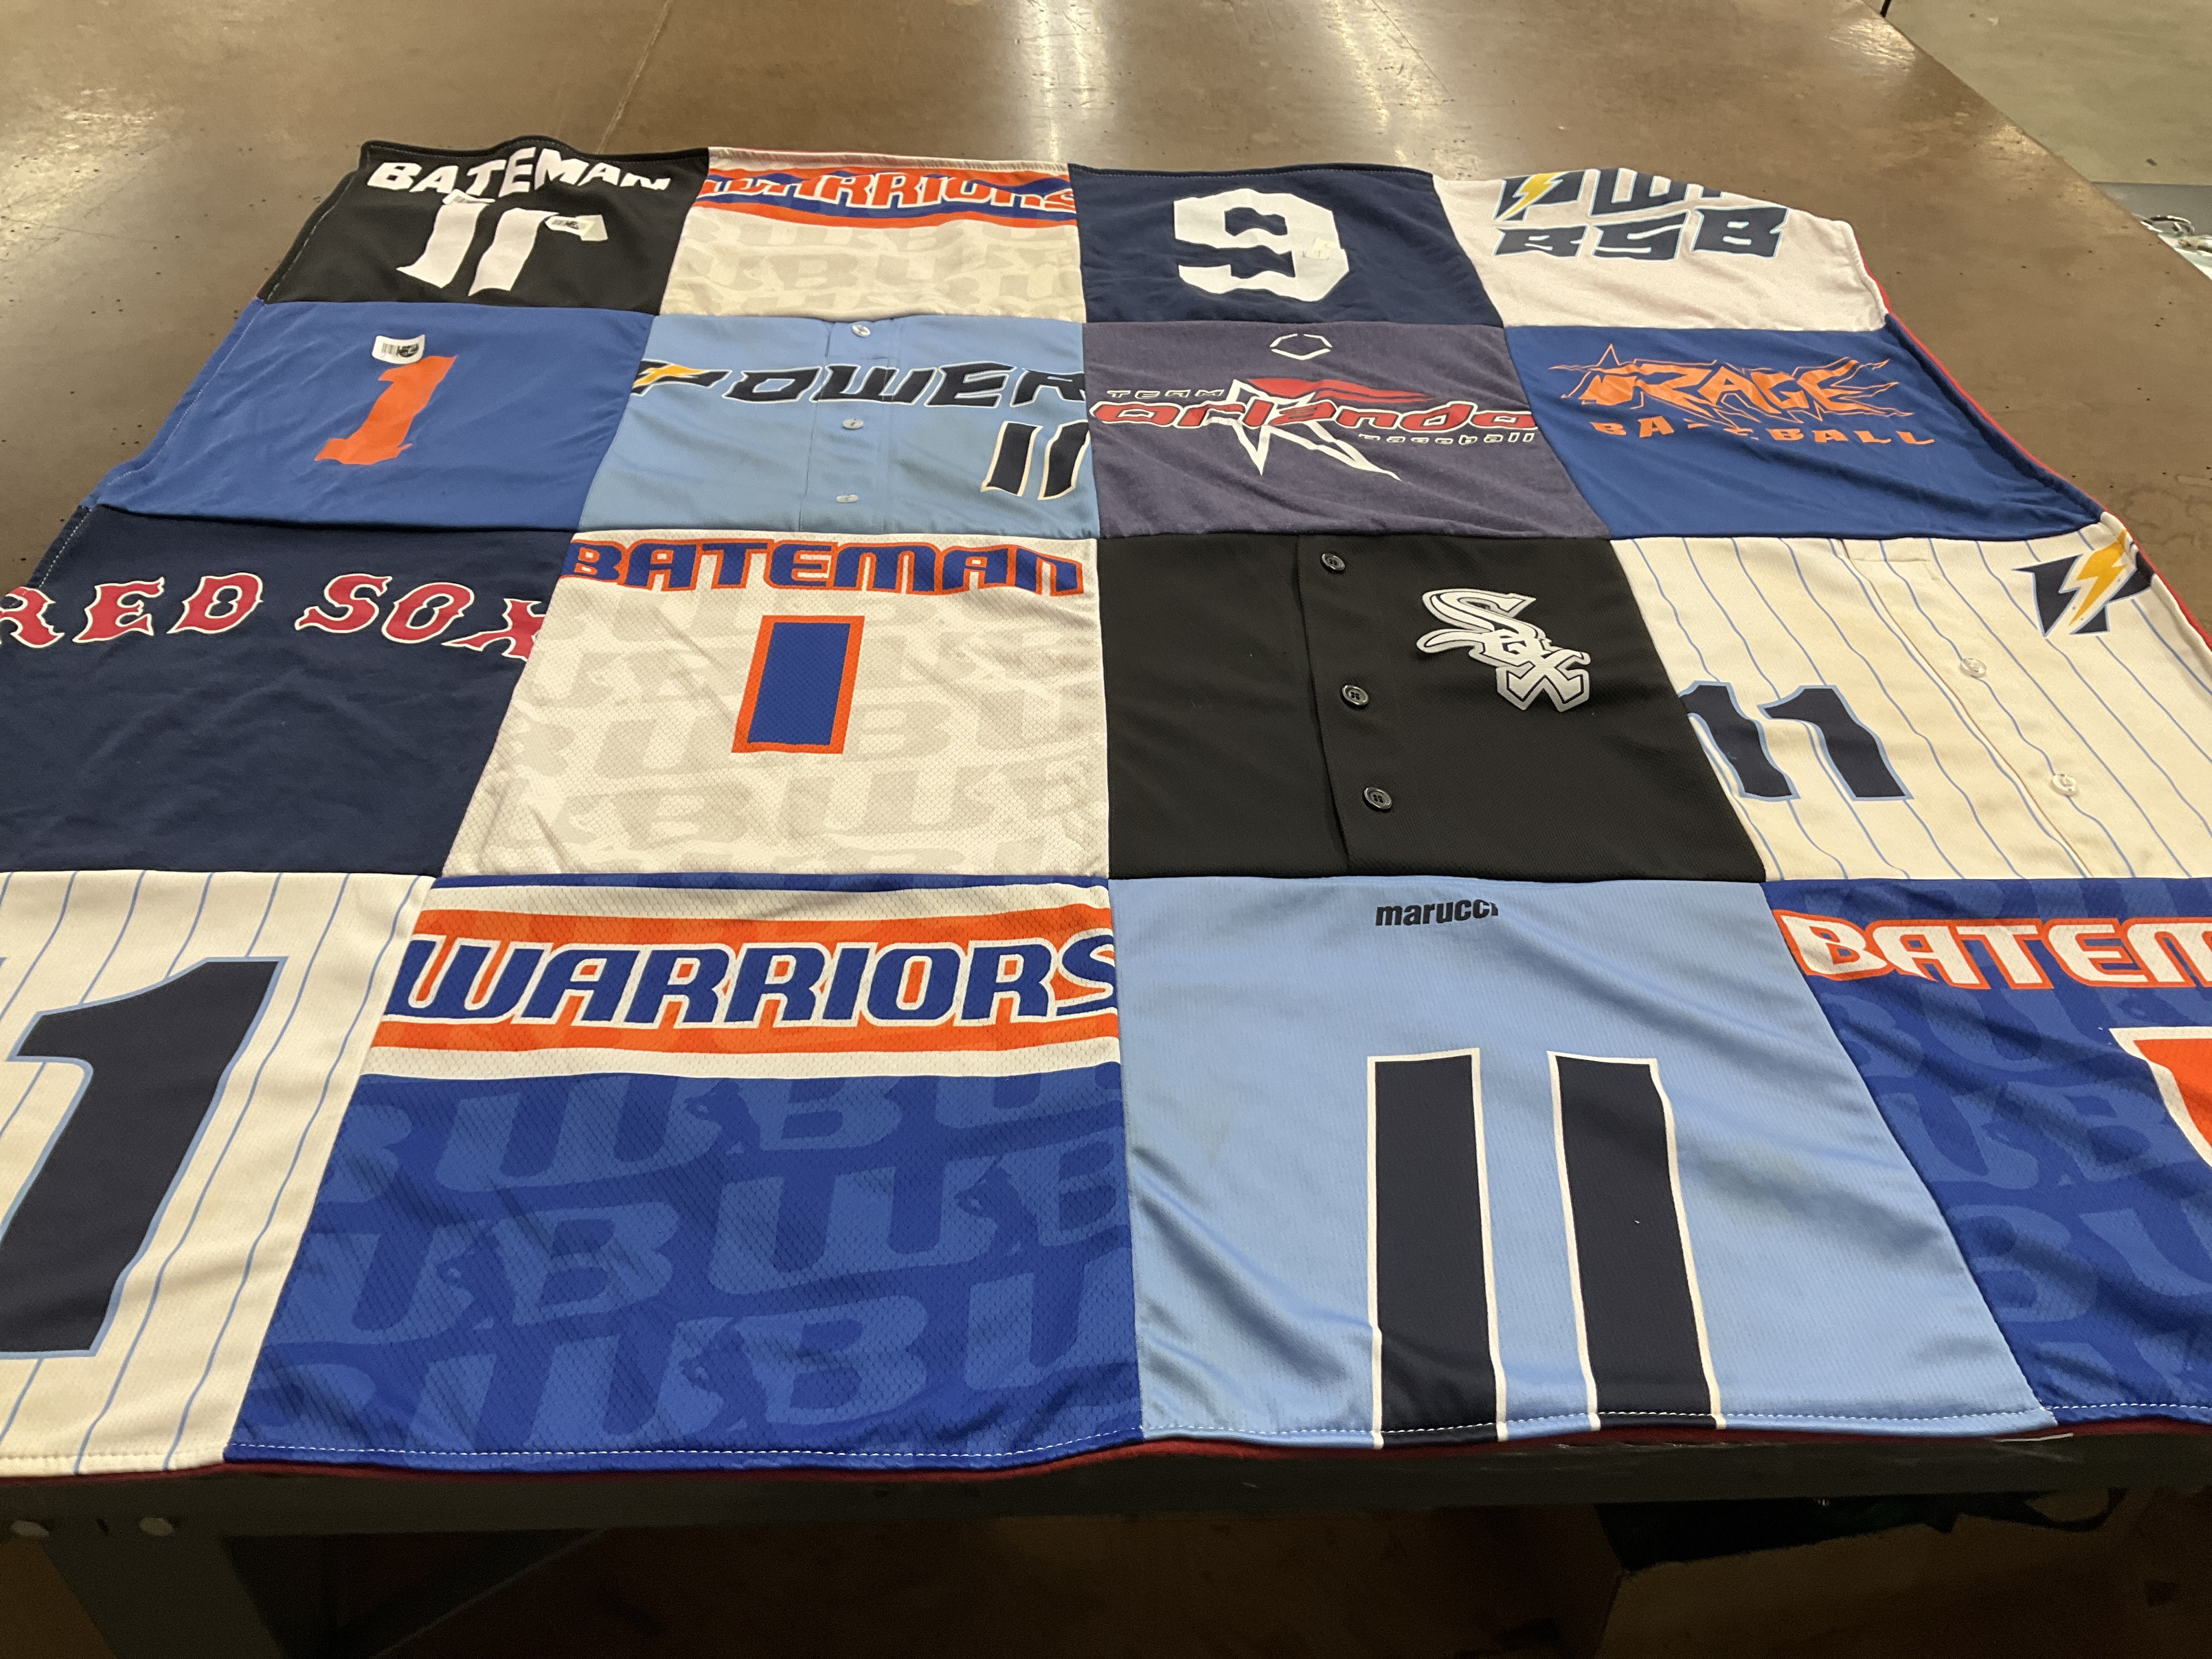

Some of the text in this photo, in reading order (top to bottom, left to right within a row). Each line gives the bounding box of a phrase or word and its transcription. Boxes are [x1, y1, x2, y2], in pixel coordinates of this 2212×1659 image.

[367, 147, 670, 198] BATEMAN
[1173, 188, 1350, 301] 9
[314, 356, 458, 465] 1
[630, 358, 1086, 408] POWER
[1564, 354, 1901, 421] RAGE
[1590, 415, 1934, 445] BABALL
[558, 538, 1084, 596] BATEMAN
[0, 572, 263, 648] RED
[1679, 680, 1914, 802] 11
[383, 927, 1118, 1029] WARRIORS
